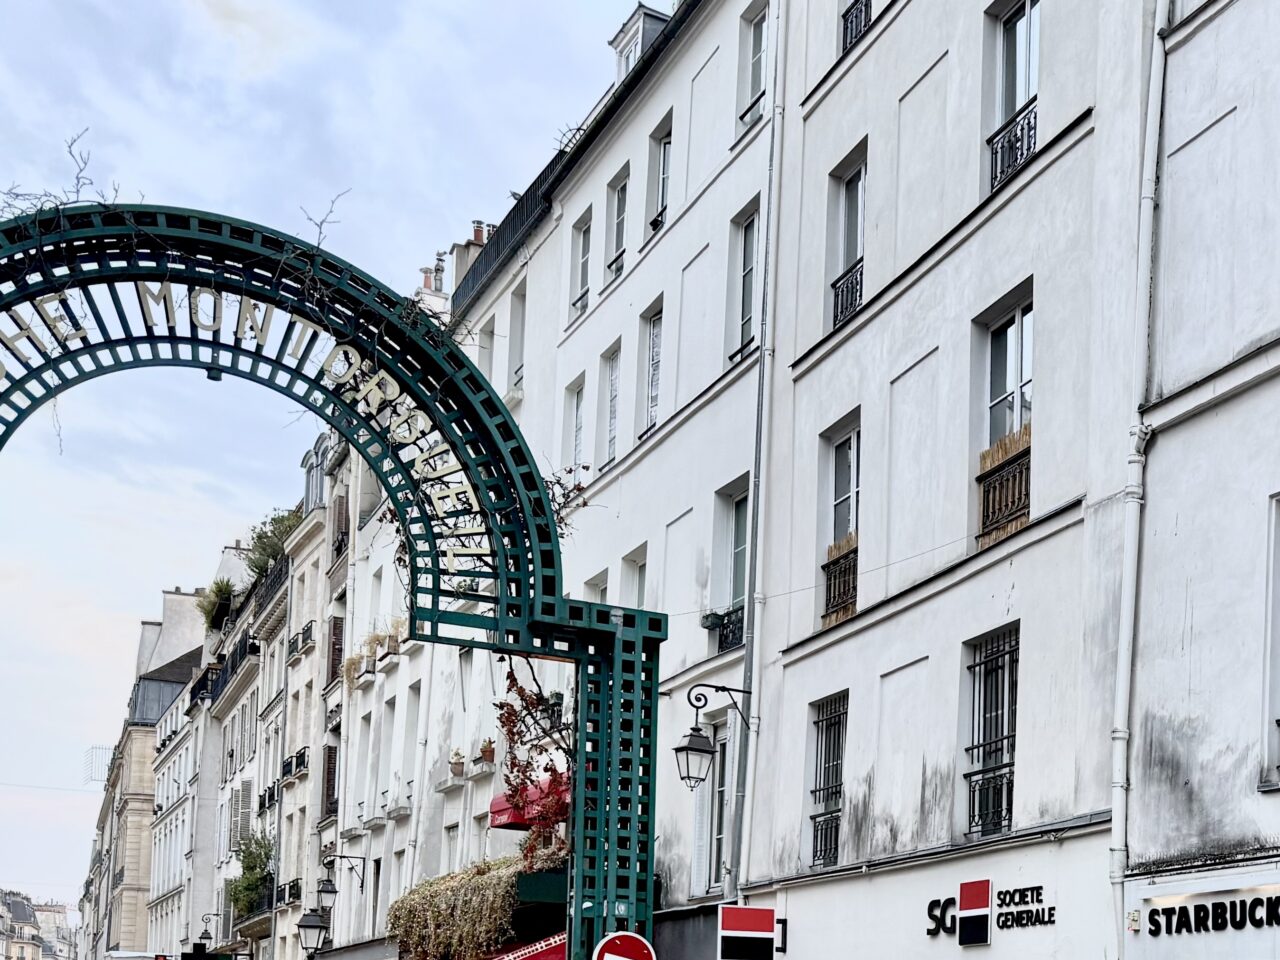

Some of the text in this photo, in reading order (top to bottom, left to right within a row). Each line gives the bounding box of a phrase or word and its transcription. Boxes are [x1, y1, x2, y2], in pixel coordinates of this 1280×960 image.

[137, 281, 492, 574] MONTORGUEIL
[996, 885, 1043, 908] SOCIETE
[926, 897, 957, 937] SG
[996, 906, 1056, 930] GENERALE
